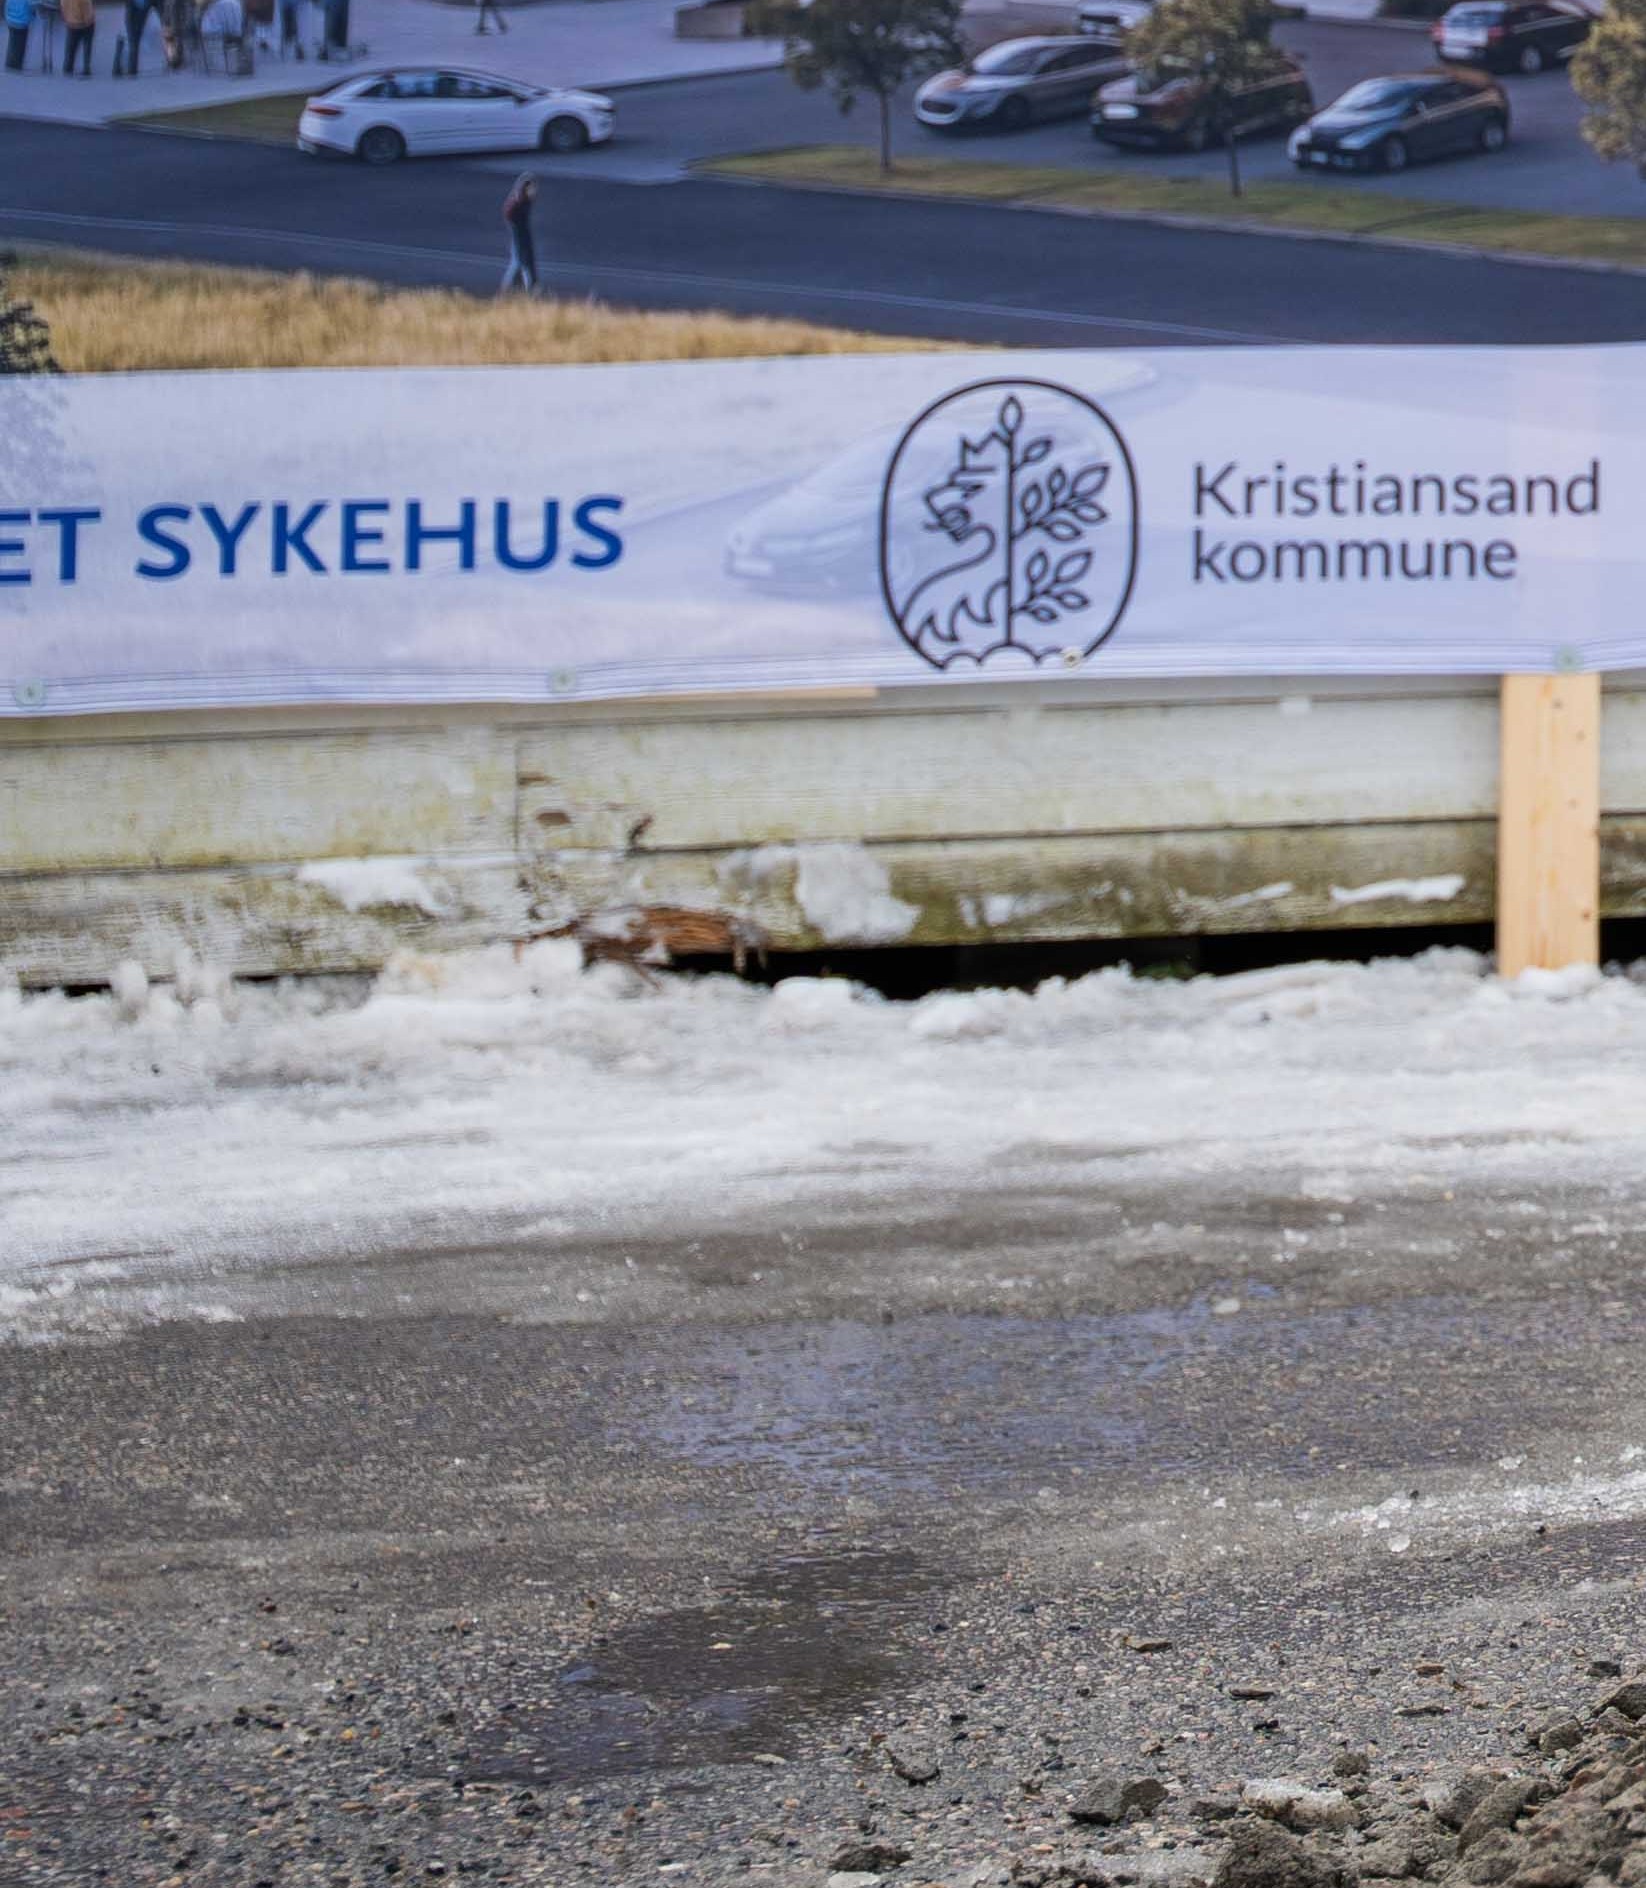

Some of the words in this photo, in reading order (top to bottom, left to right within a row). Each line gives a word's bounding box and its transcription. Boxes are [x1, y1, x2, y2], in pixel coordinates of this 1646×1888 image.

[1194, 458, 1602, 517] Kristiansand
[135, 493, 625, 580] SYKEHUS
[1194, 528, 1517, 582] kommune
